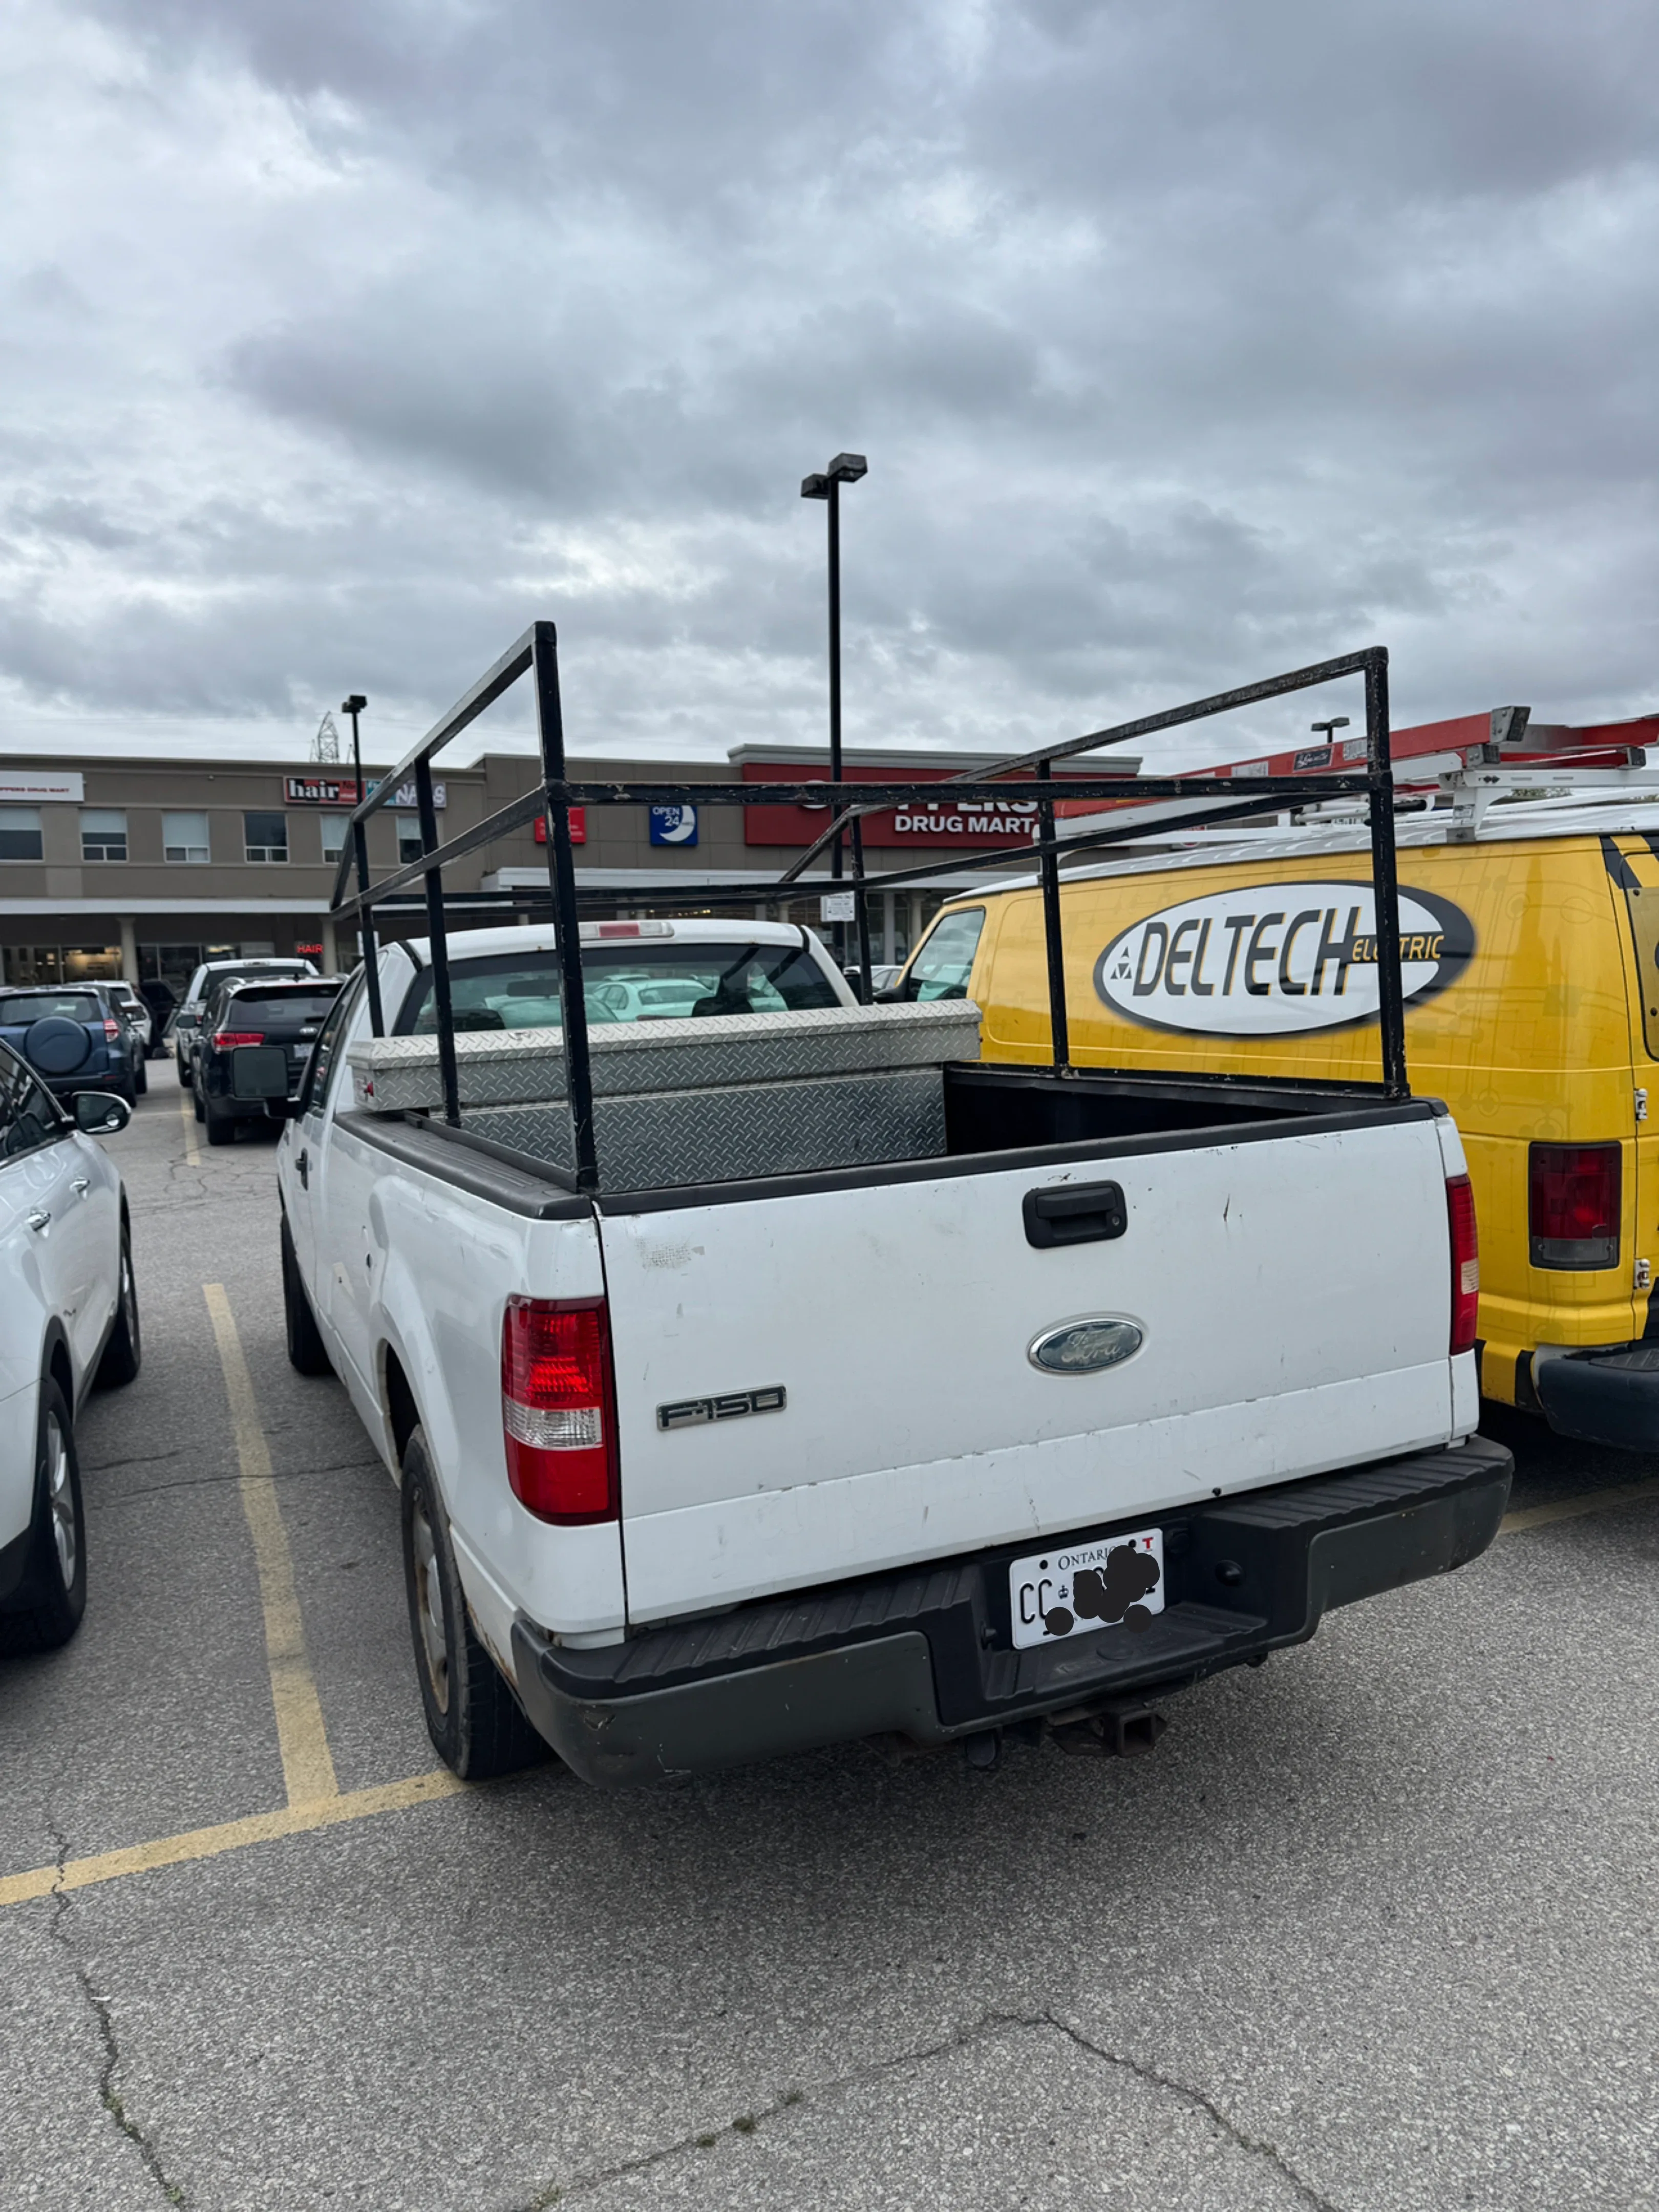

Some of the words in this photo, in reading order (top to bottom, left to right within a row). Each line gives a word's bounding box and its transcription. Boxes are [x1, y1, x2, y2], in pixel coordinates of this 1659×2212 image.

[289, 779, 339, 799] hair
[396, 783, 445, 803] NAS
[652, 806, 680, 816] OPEN
[665, 816, 679, 826] 24
[895, 815, 963, 832] DRUG
[968, 817, 1034, 834] MART
[296, 944, 323, 954] HAIR
[1132, 906, 1362, 996] DELTECH
[1352, 935, 1444, 961] ELTRIC
[1142, 1536, 1154, 1549] T
